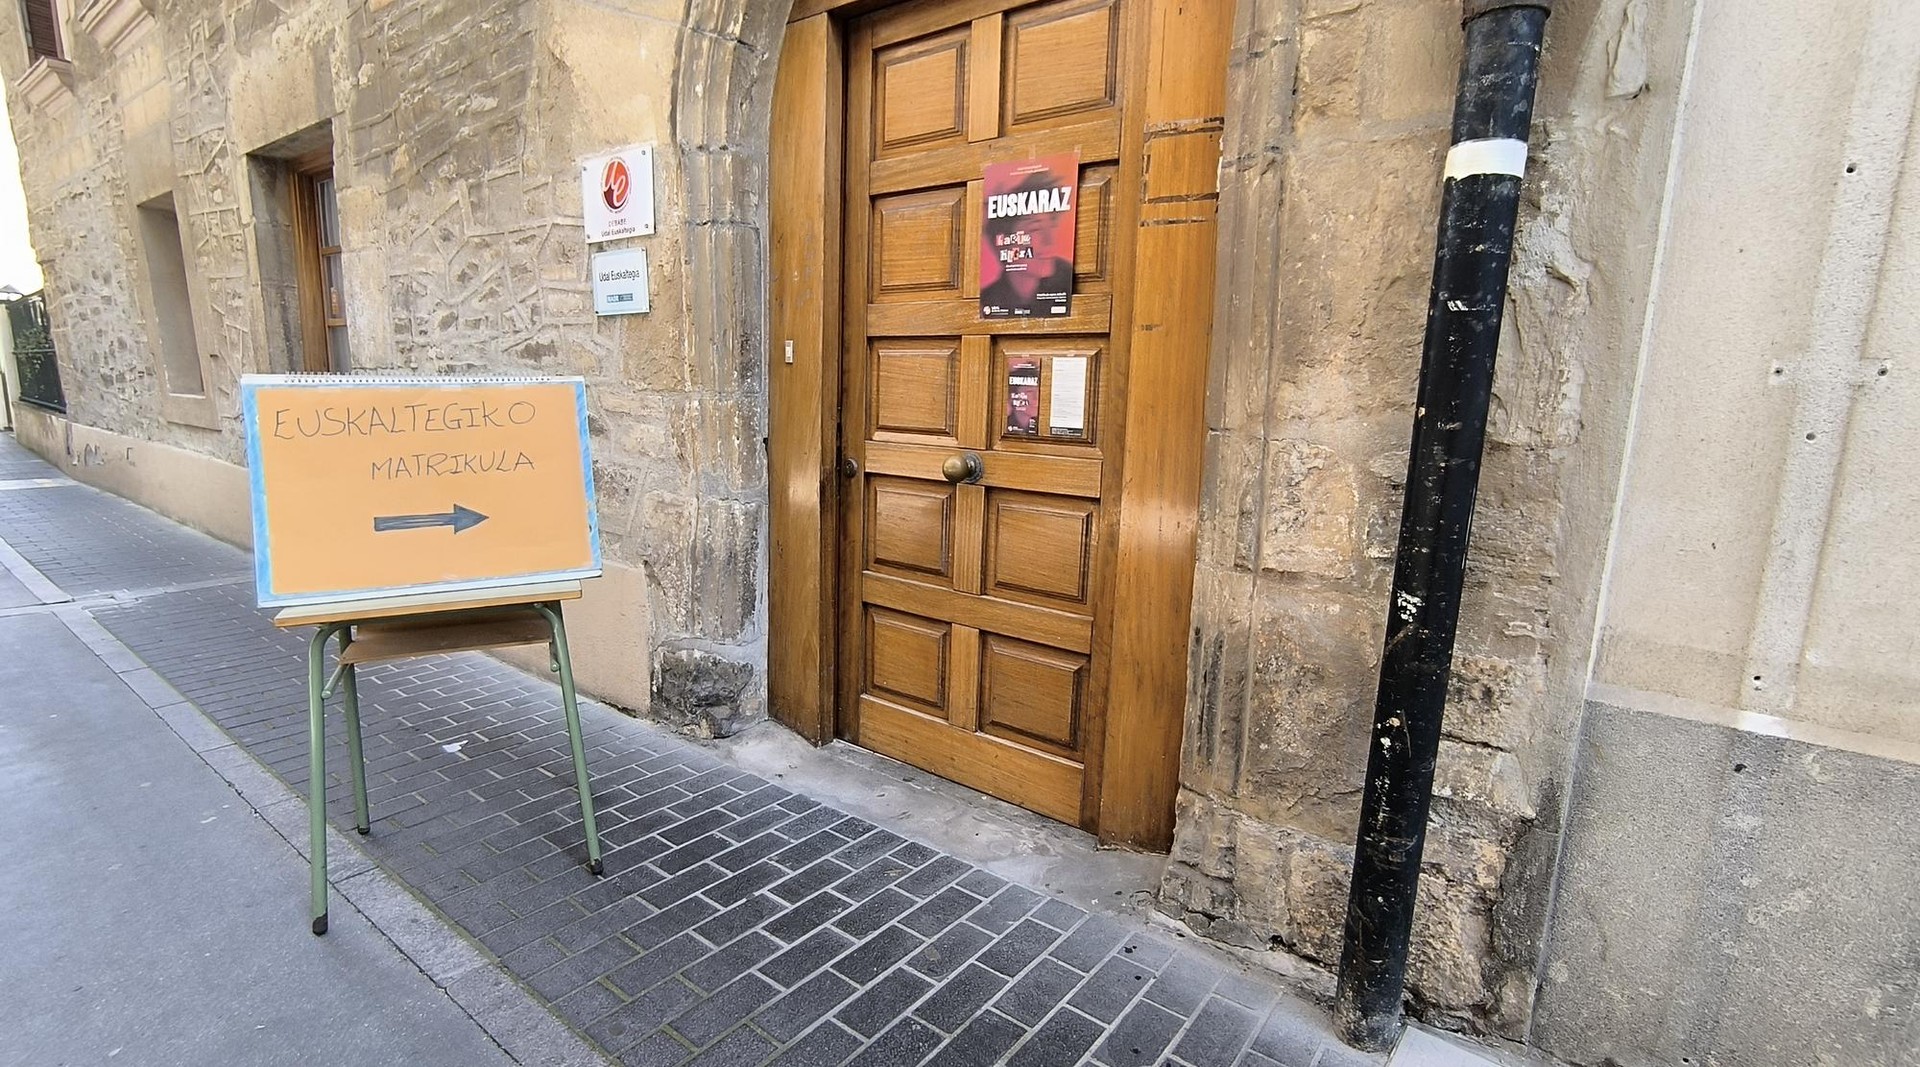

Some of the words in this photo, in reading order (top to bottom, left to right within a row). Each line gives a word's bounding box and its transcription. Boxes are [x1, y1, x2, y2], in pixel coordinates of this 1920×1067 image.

[987, 187, 1072, 219] EUSKARAZ
[599, 271, 610, 282] Udal
[611, 269, 640, 281] Euskaltegia
[274, 401, 536, 440] EUSKALTEGIKO
[371, 450, 535, 480] MATRIKULA
